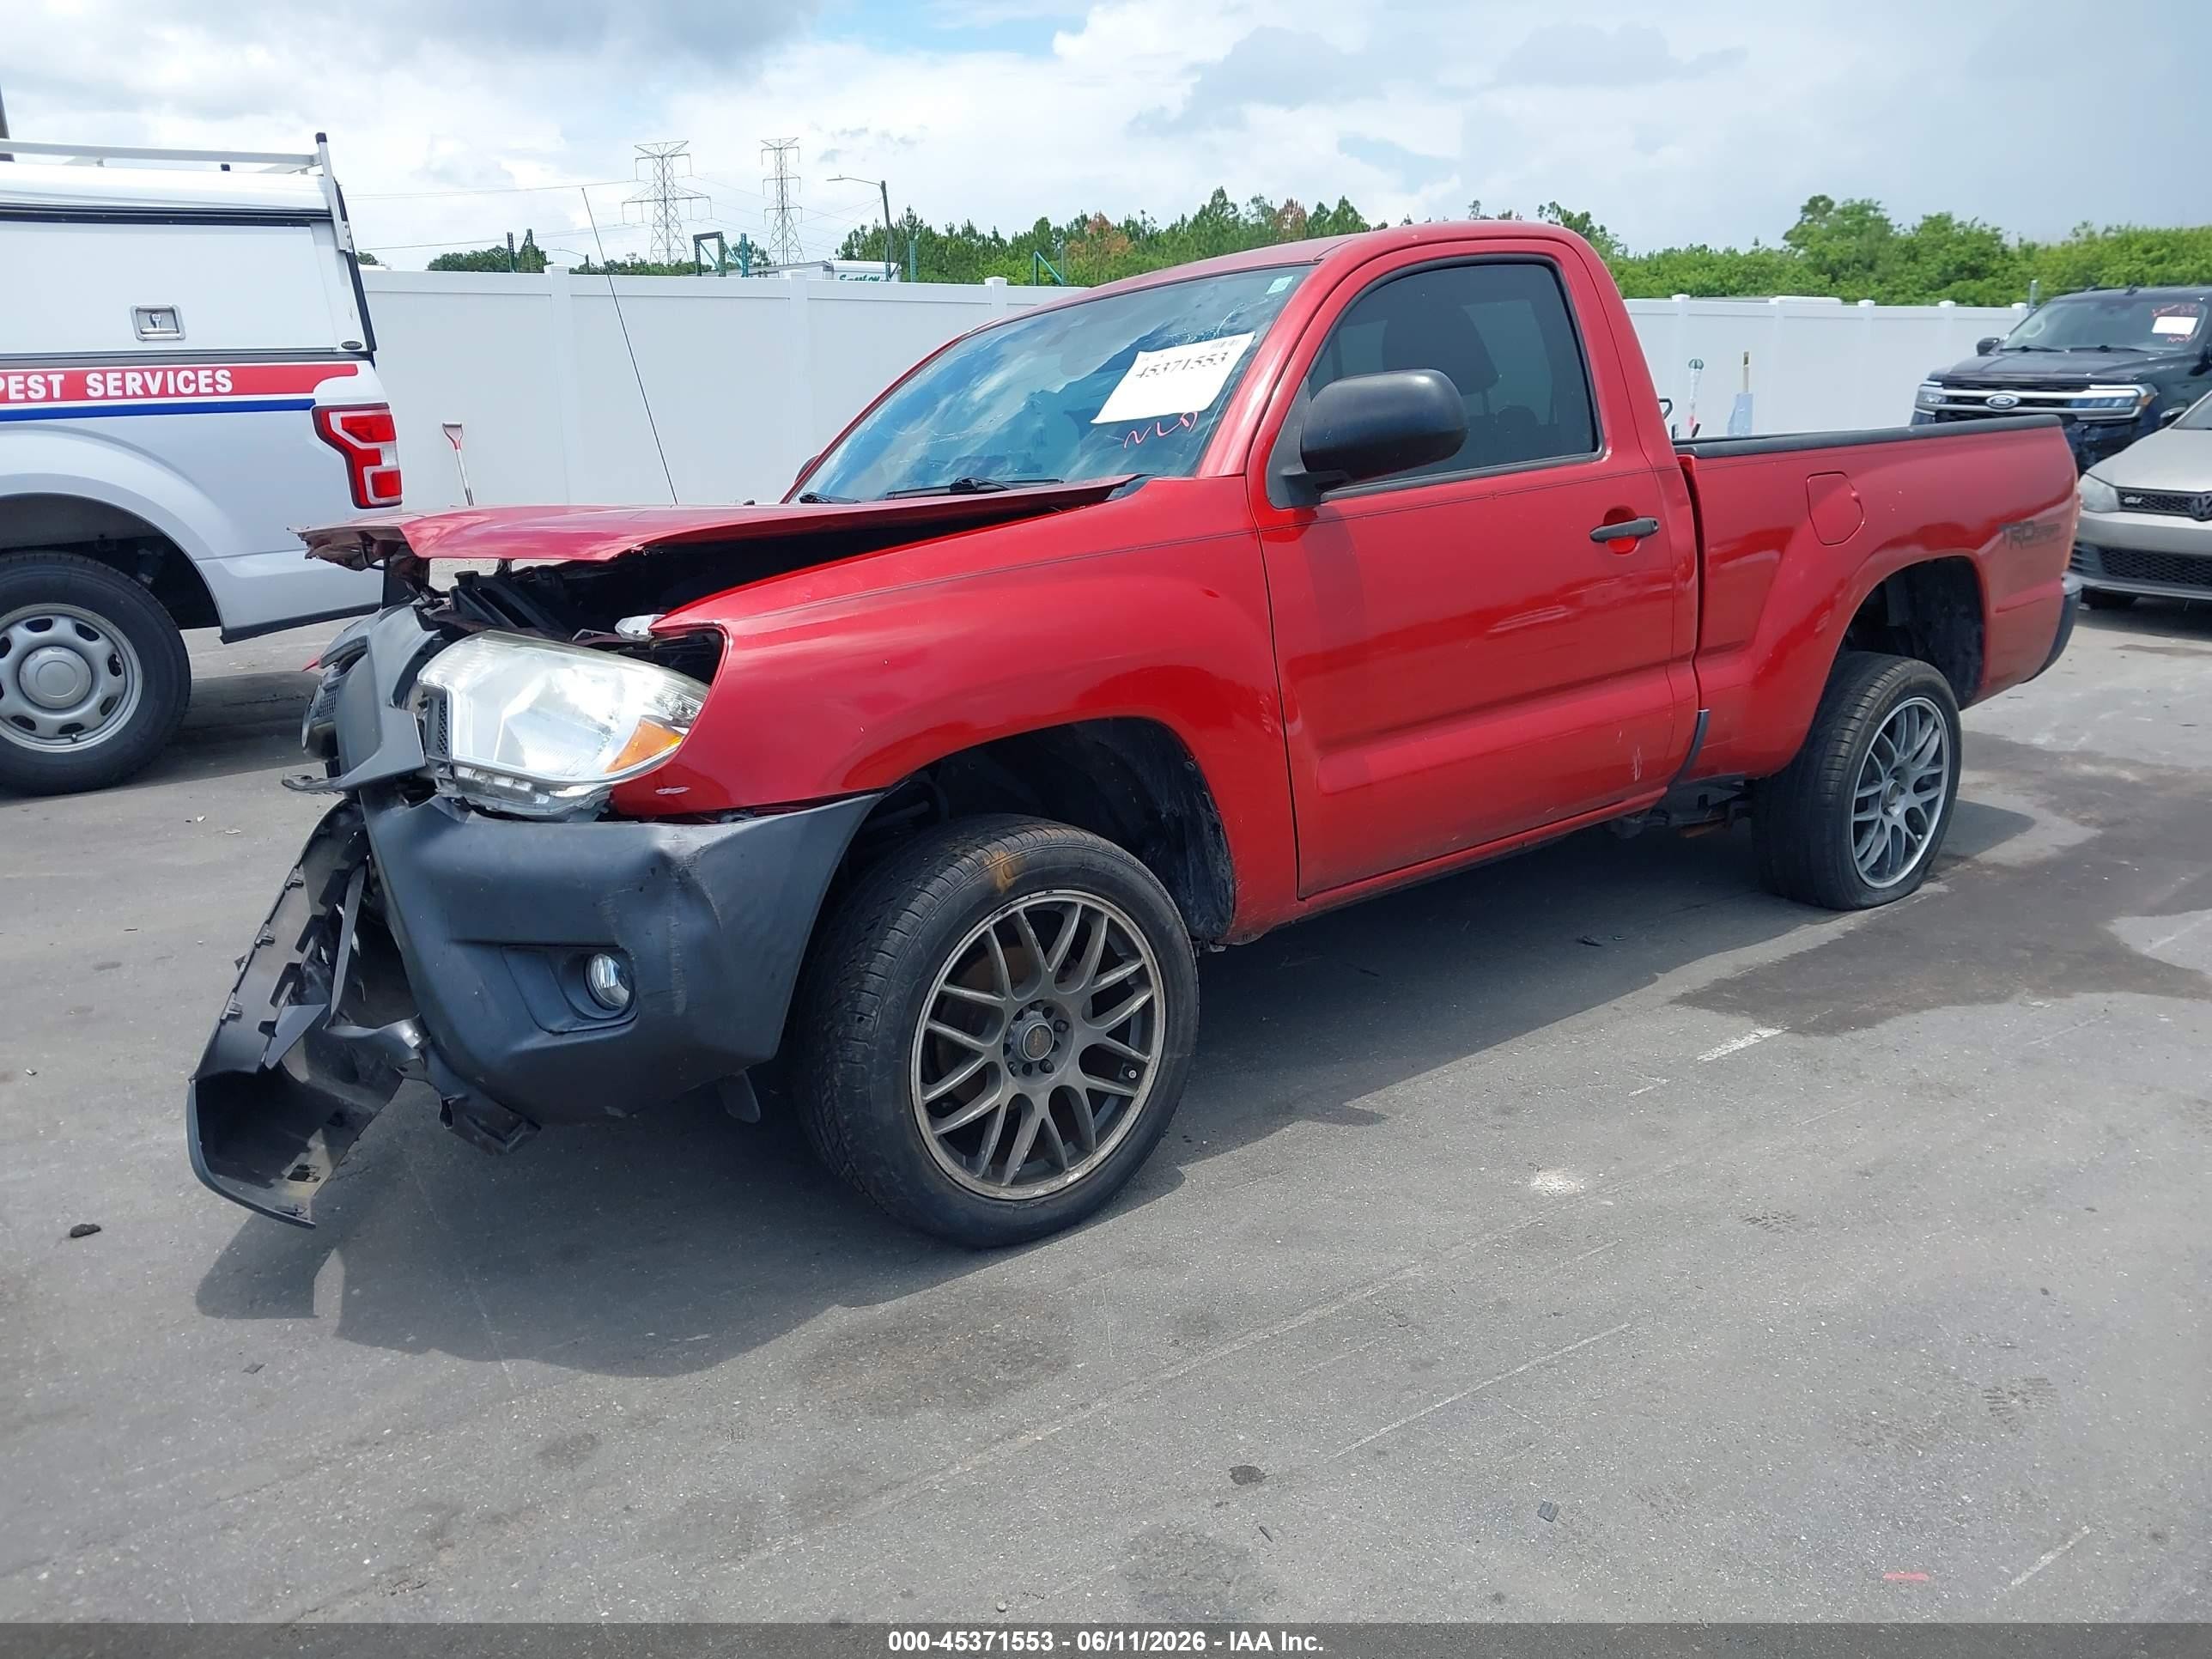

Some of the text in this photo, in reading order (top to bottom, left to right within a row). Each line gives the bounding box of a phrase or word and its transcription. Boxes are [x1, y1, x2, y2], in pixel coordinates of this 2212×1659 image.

[1135, 349, 1230, 379] 45371553
[0, 369, 234, 400] EST SERVICES
